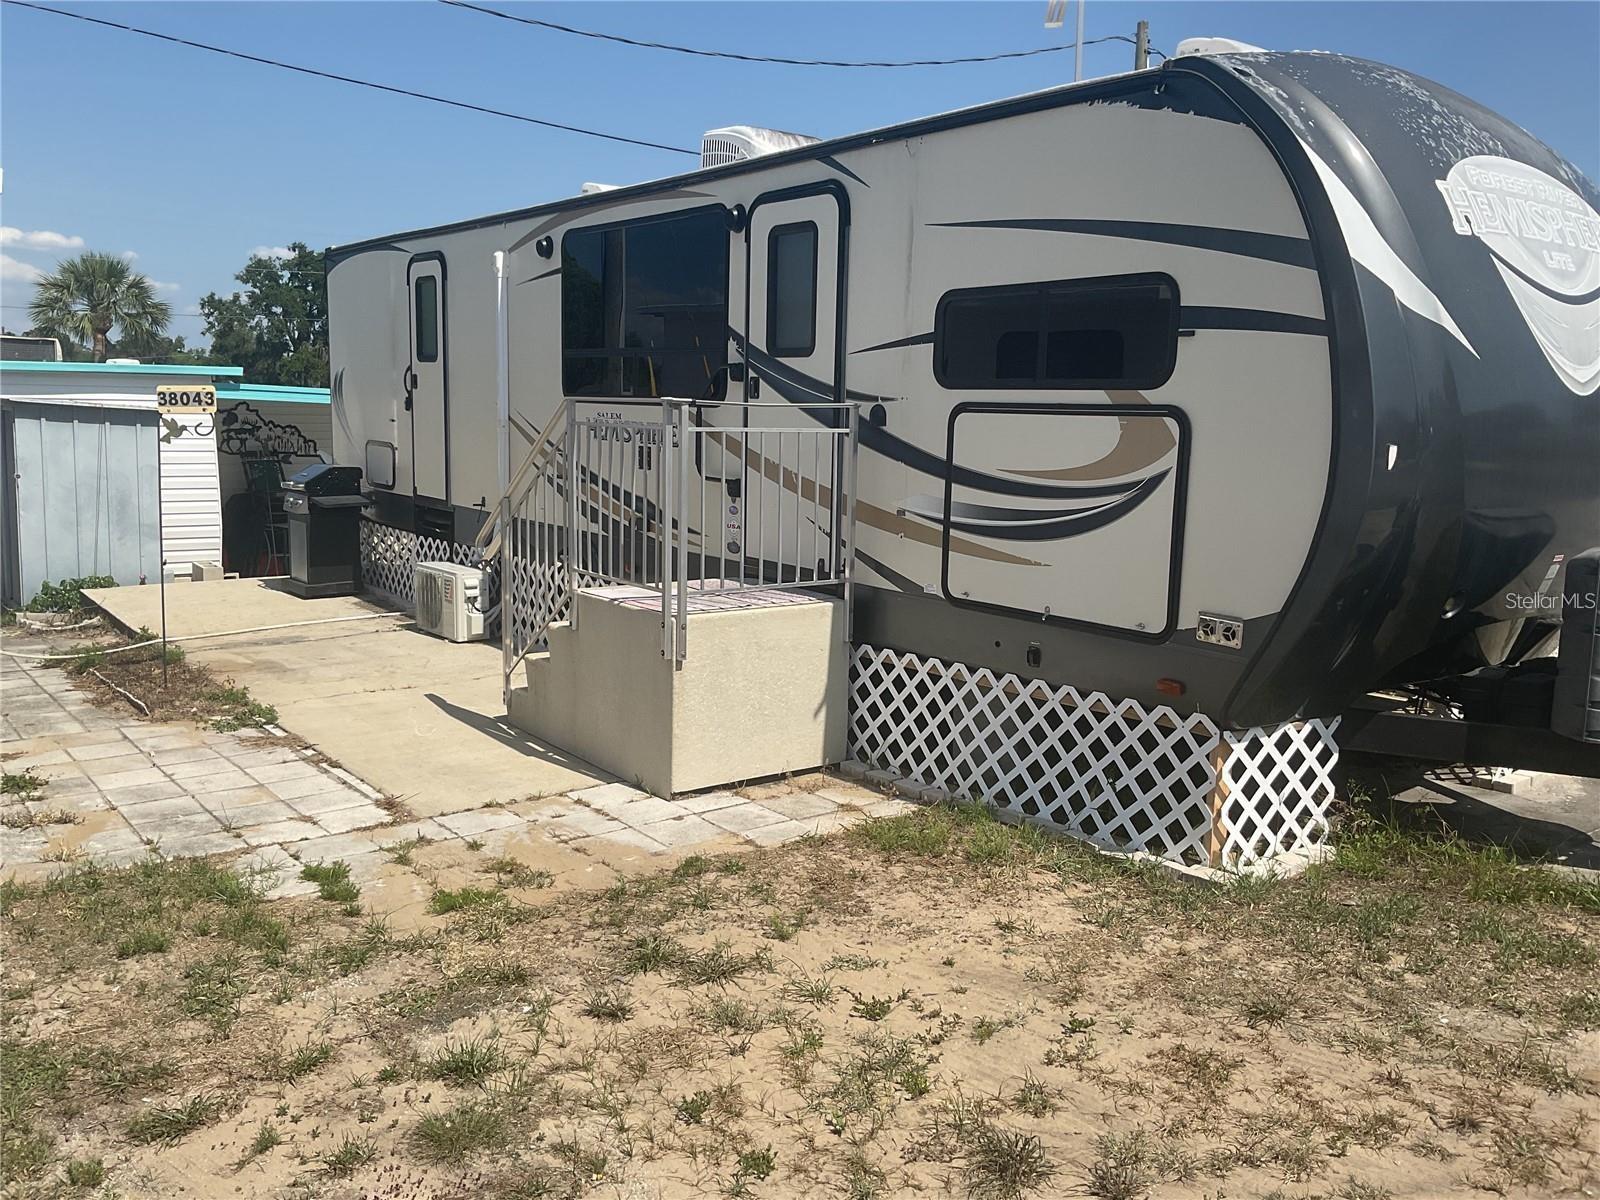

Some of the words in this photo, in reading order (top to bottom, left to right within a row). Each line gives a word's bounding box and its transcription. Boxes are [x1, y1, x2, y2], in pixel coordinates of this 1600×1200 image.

[1435, 180, 1600, 253] HEMISPHE
[157, 391, 215, 407] 38043
[597, 412, 622, 420] SALEM
